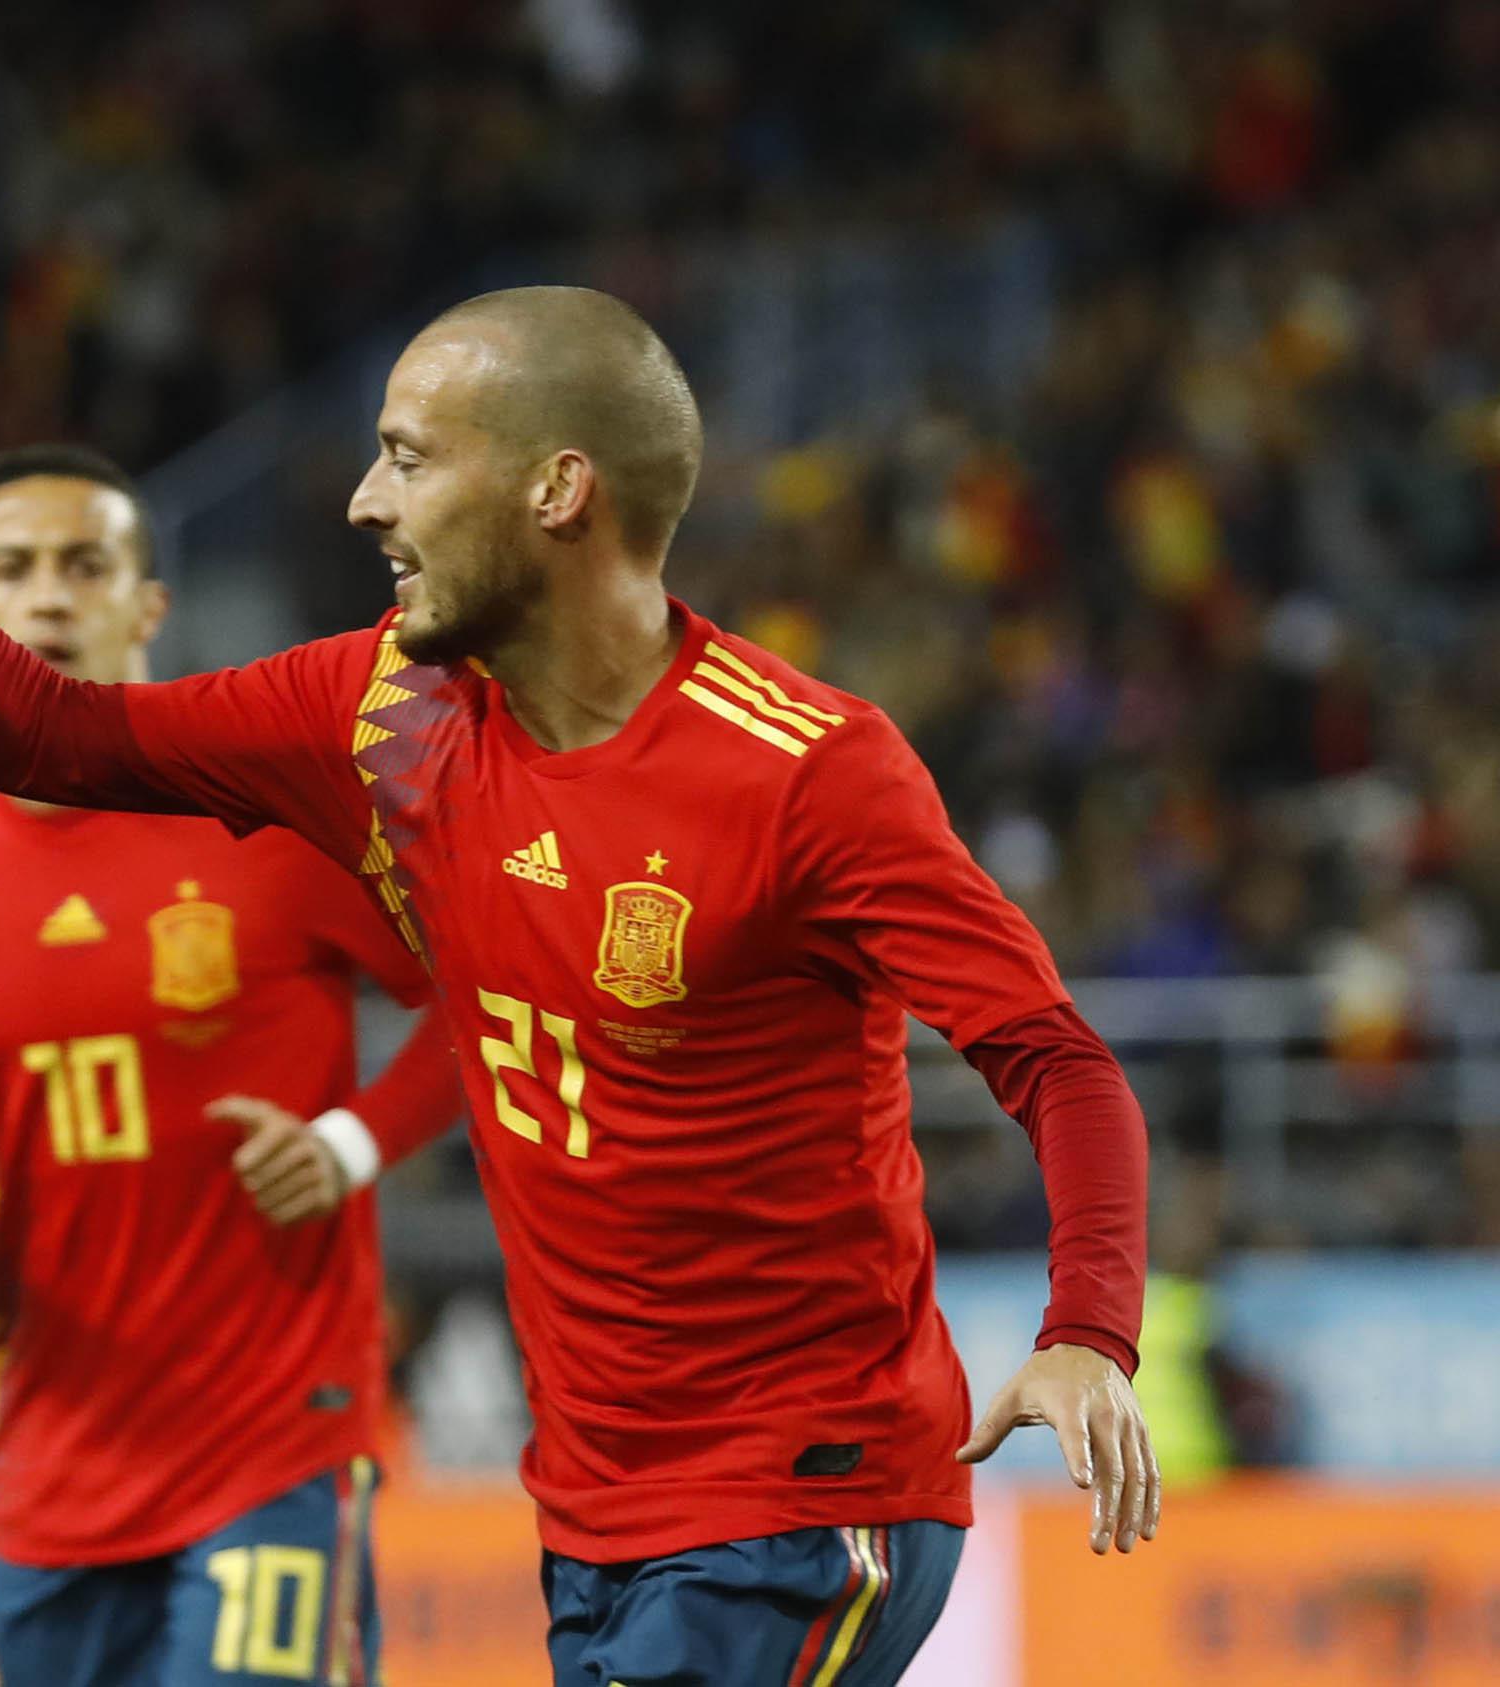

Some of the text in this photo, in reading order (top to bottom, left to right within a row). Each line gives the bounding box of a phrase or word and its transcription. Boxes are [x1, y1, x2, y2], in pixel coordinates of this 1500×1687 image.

[502, 858, 568, 890] adidas
[22, 1034, 148, 1162] 10
[477, 986, 590, 1159] 21
[207, 1545, 325, 1680] 10
